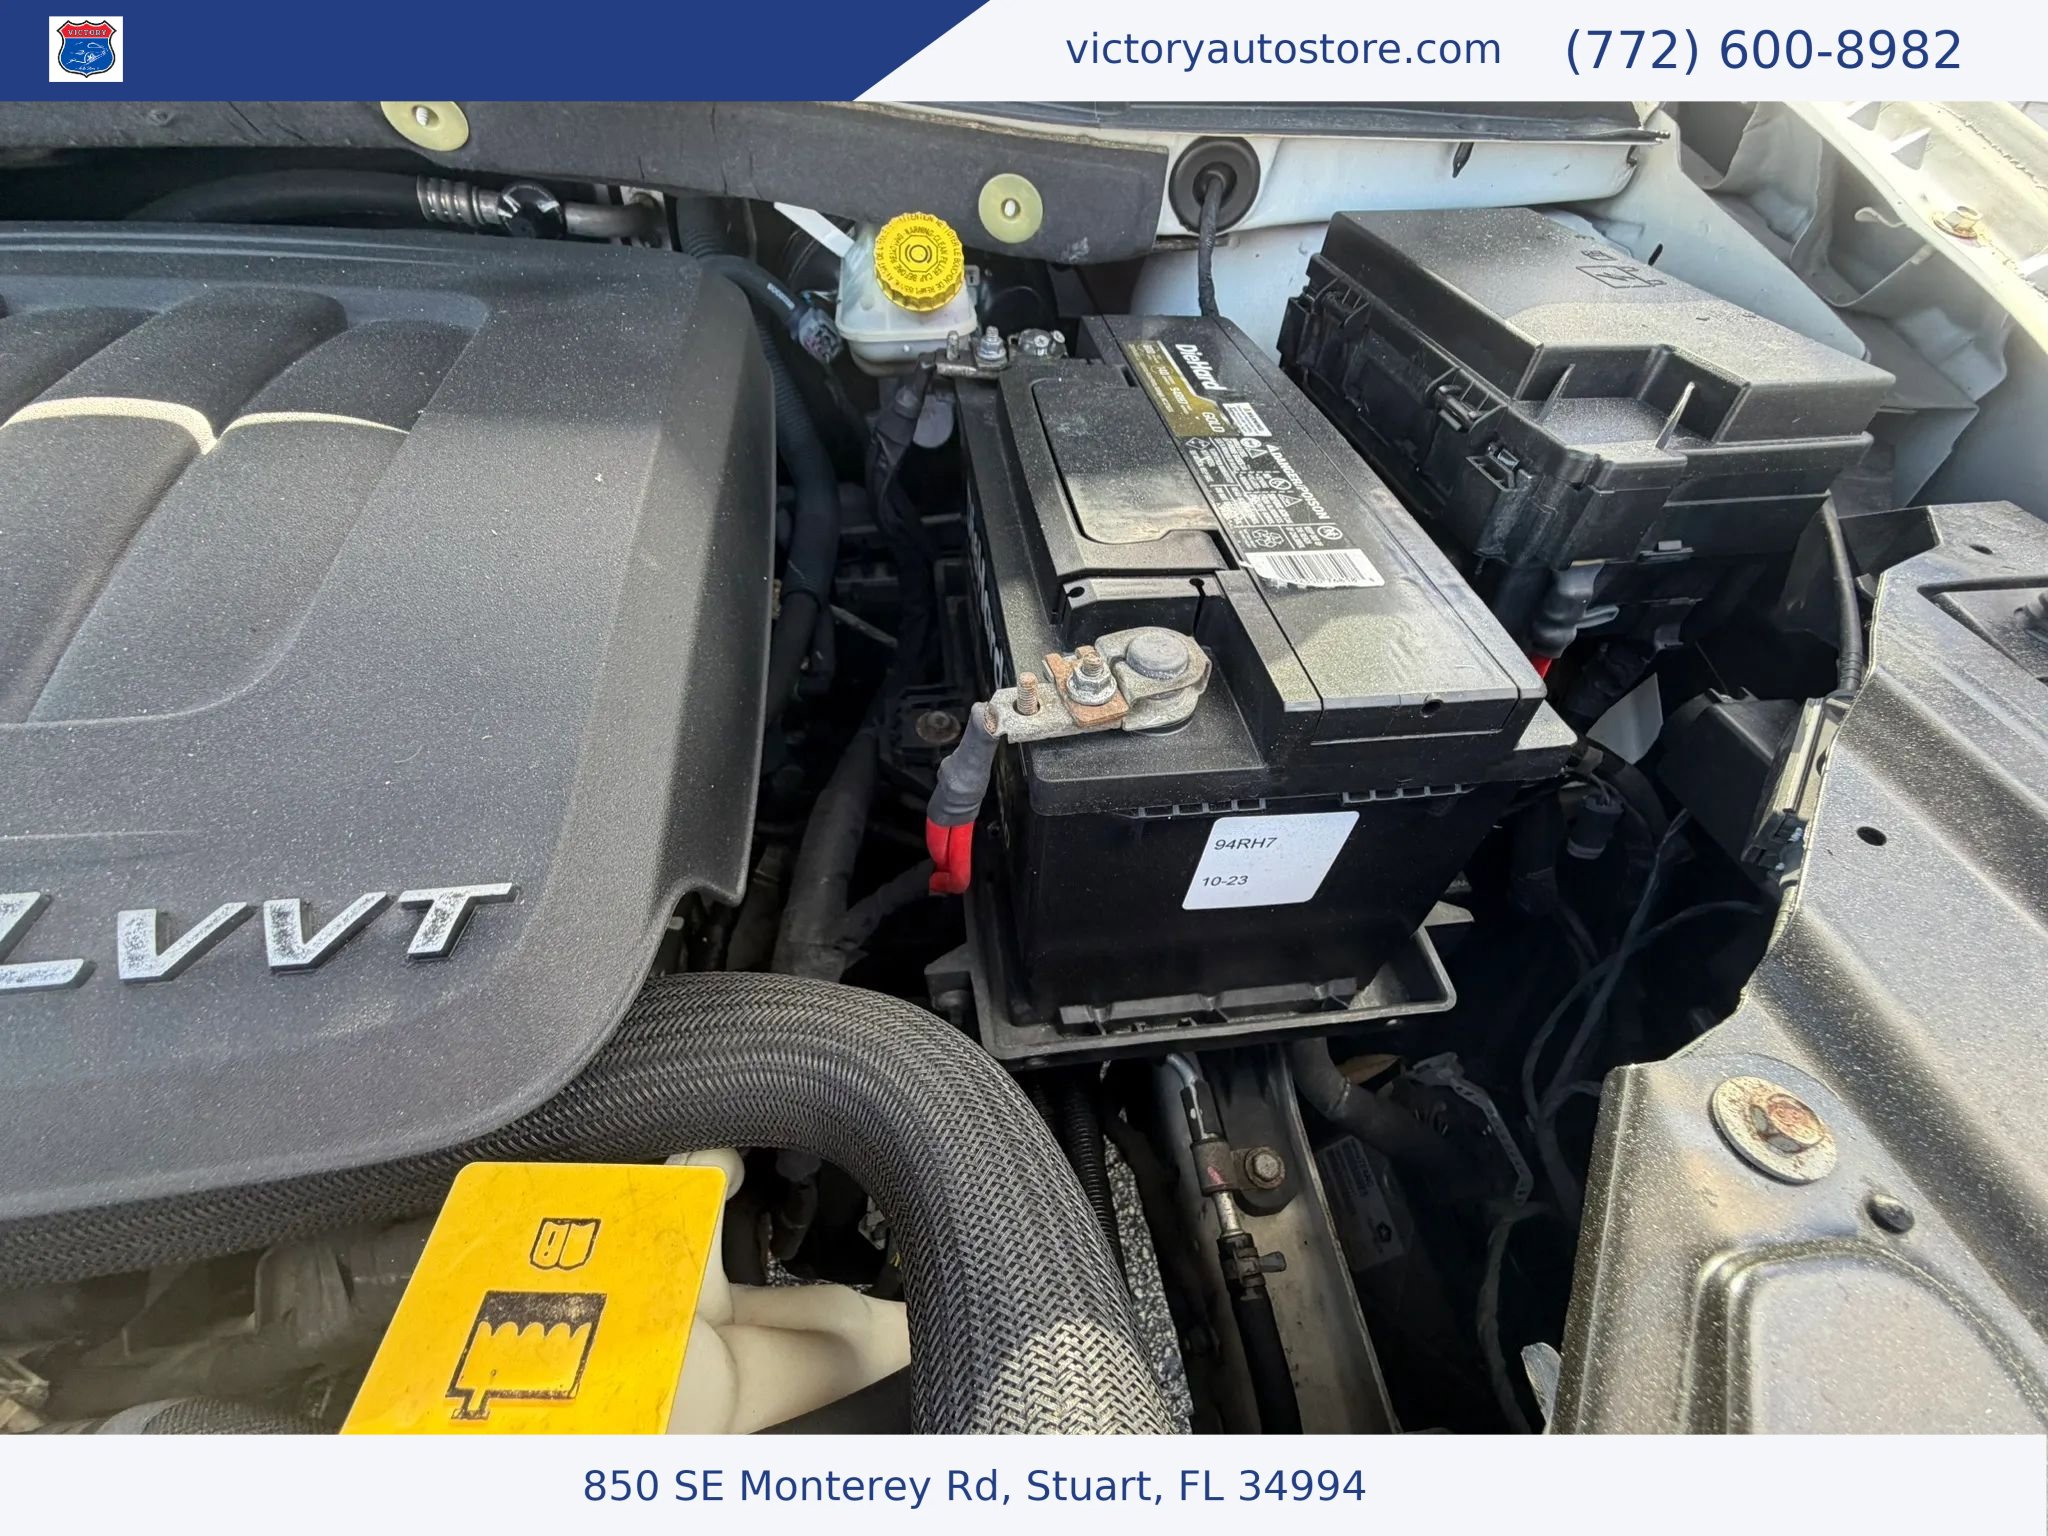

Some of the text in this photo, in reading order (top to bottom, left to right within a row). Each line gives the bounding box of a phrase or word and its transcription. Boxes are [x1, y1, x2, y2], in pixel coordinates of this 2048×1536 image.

[1175, 344, 1228, 391] DieHard
[1202, 411, 1226, 433] GOLD
[1270, 451, 1331, 520] DANGER/POISON
[1213, 837, 1278, 850] 94RH7
[1202, 875, 1249, 887] 10-23
[118, 882, 514, 982] VVT
